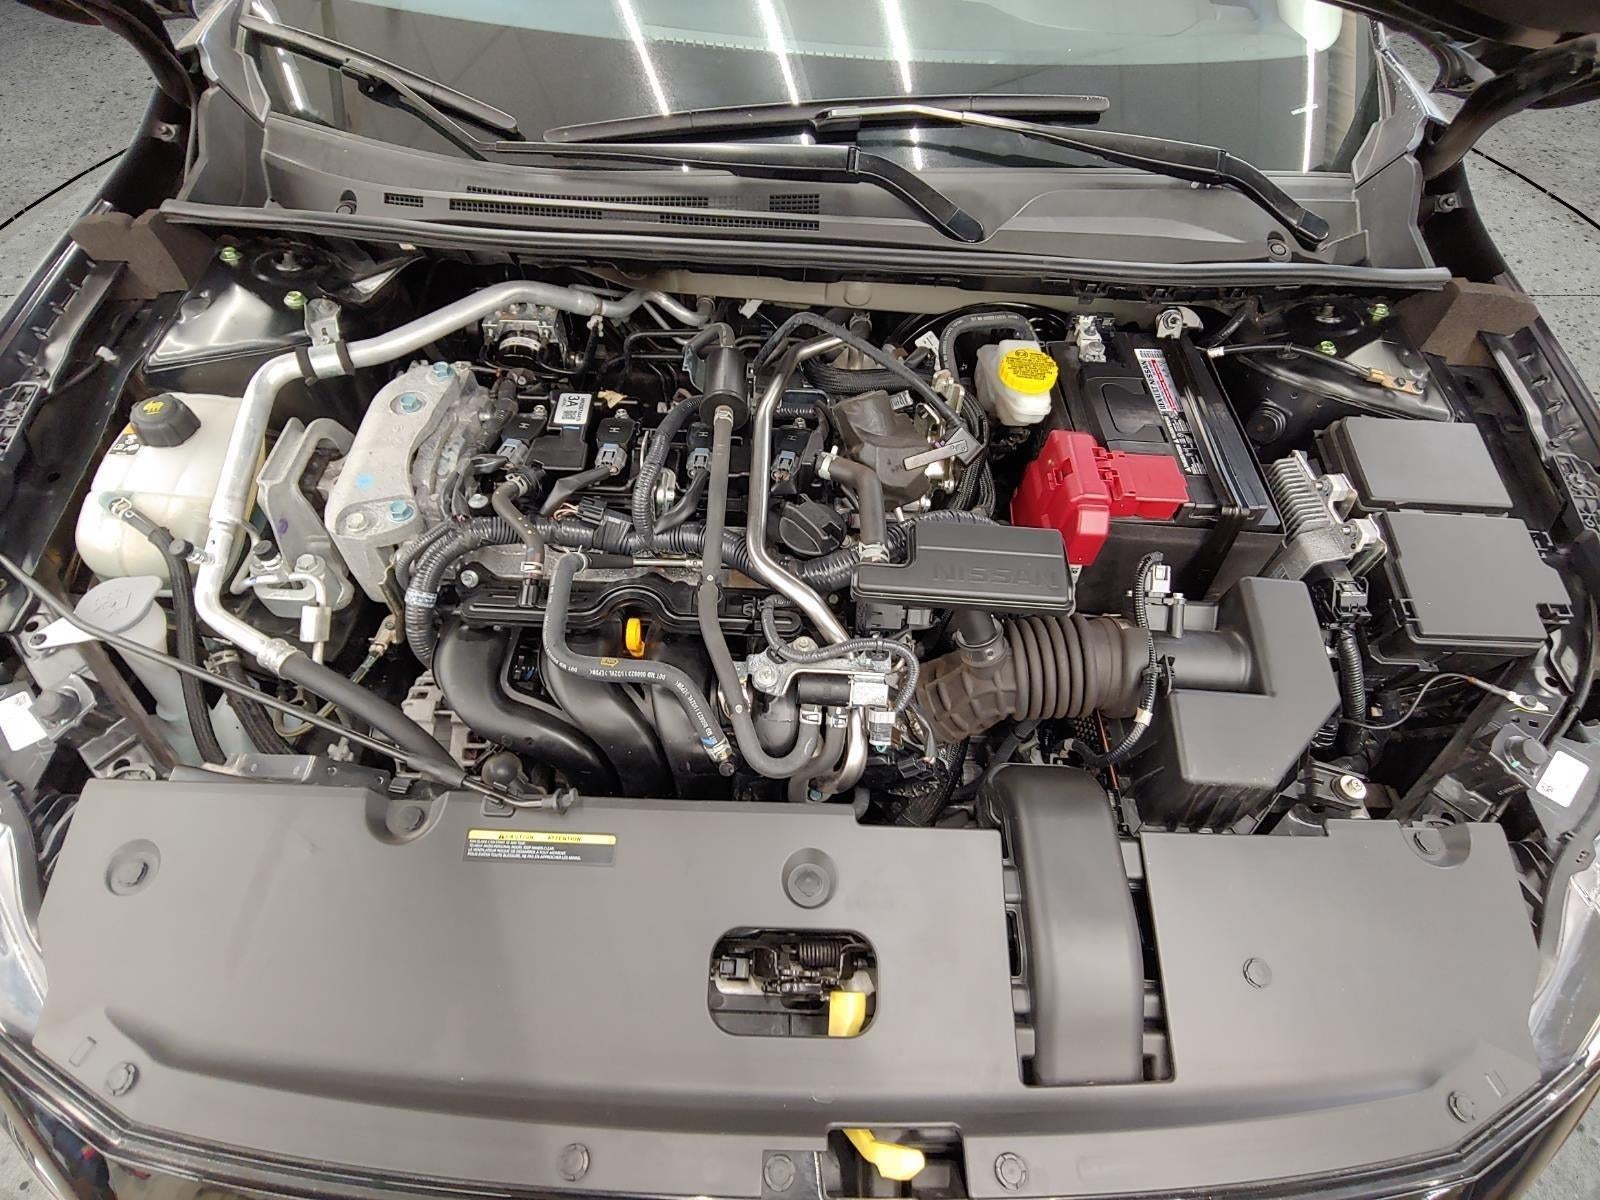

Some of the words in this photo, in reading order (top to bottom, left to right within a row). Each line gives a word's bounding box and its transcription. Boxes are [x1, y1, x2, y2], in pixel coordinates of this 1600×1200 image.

[1141, 360, 1154, 385] NISSAN
[567, 395, 580, 407] 3A
[1152, 384, 1166, 410] RENAULT
[932, 564, 1059, 588] NISSAN
